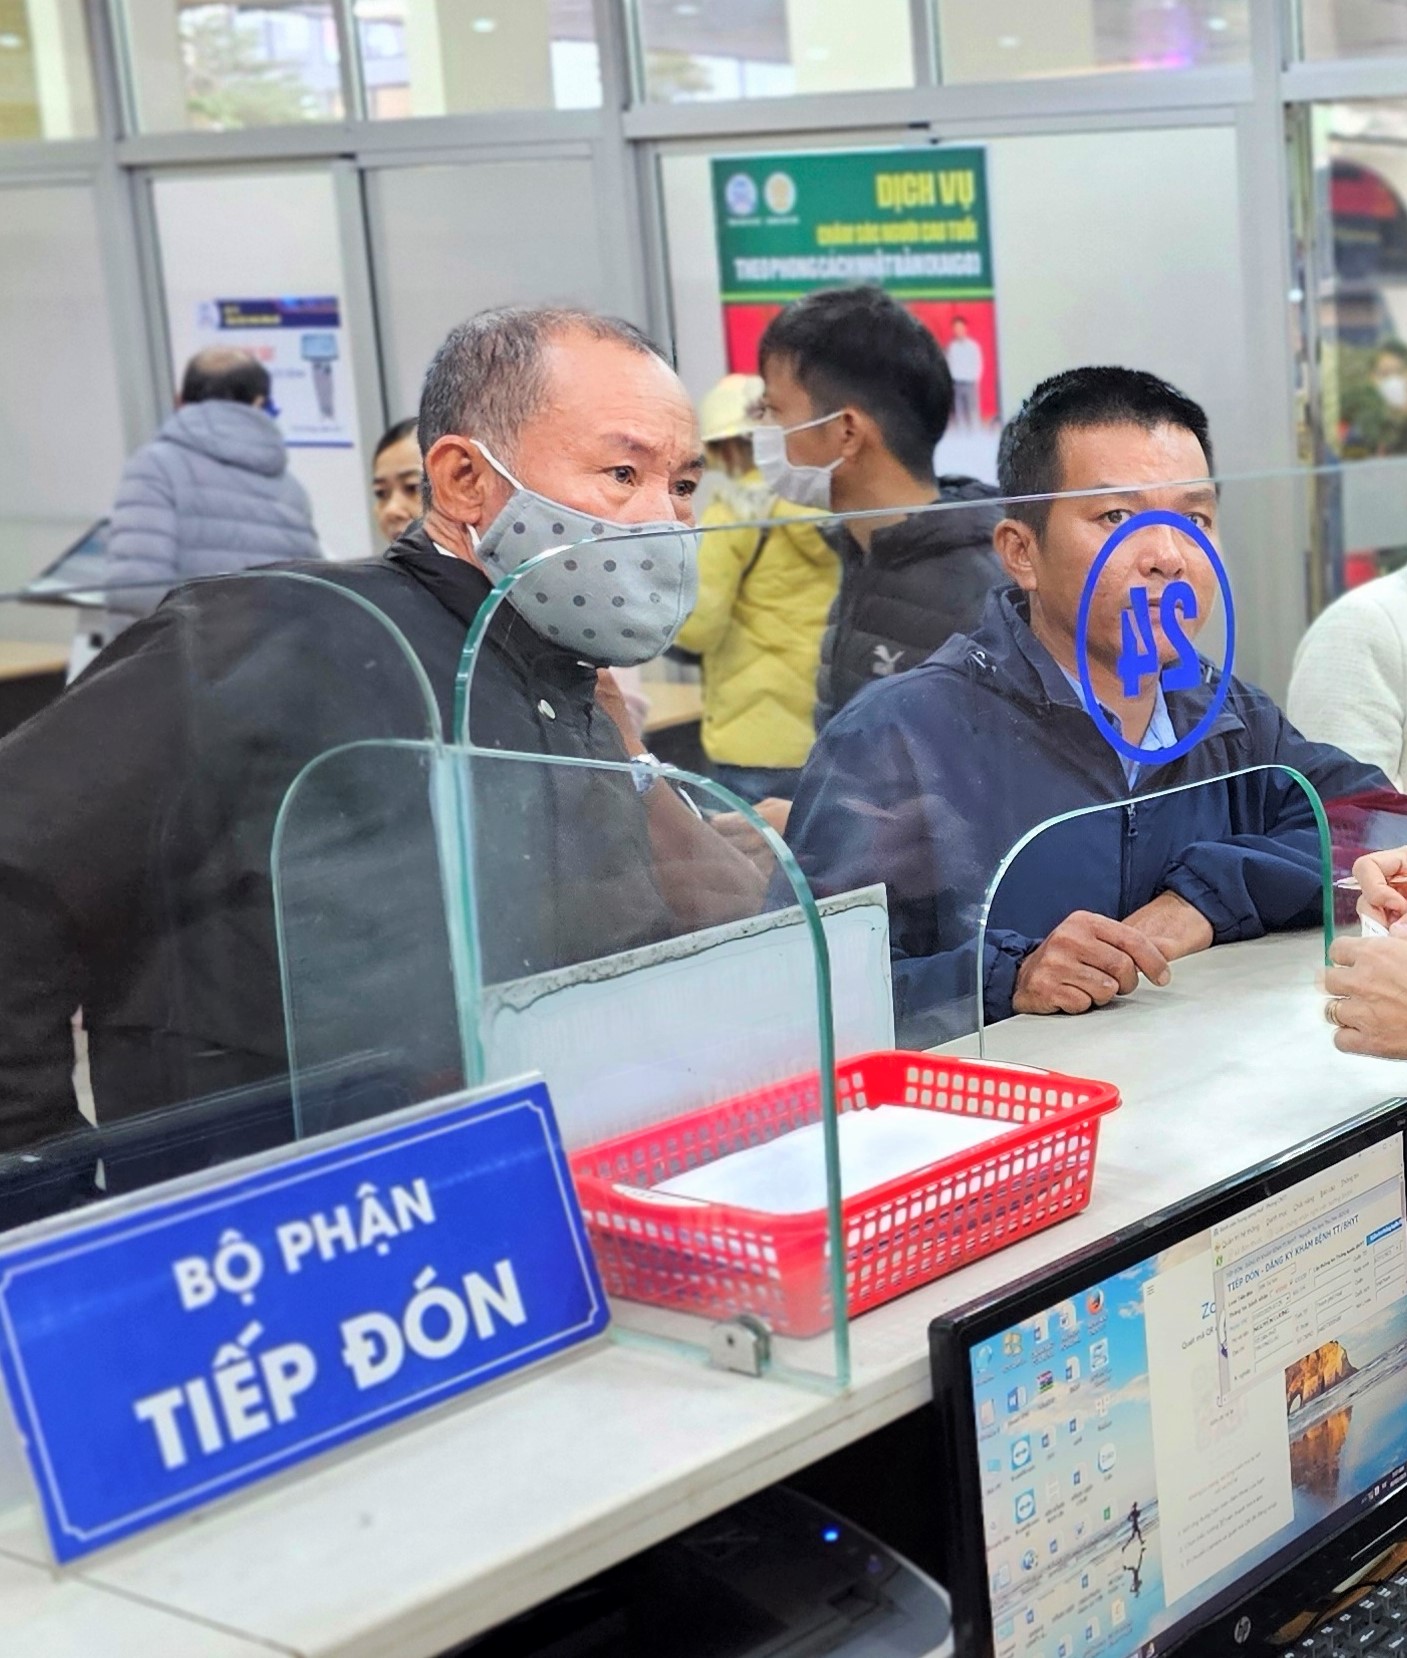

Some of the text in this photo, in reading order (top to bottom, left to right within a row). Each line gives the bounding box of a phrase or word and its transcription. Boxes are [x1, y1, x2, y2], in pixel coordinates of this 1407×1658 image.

[875, 169, 975, 213] DỊCH VỤ
[172, 1178, 437, 1312] BỘ PHẬN
[132, 1259, 528, 1470] TIẾP ĐÓN
